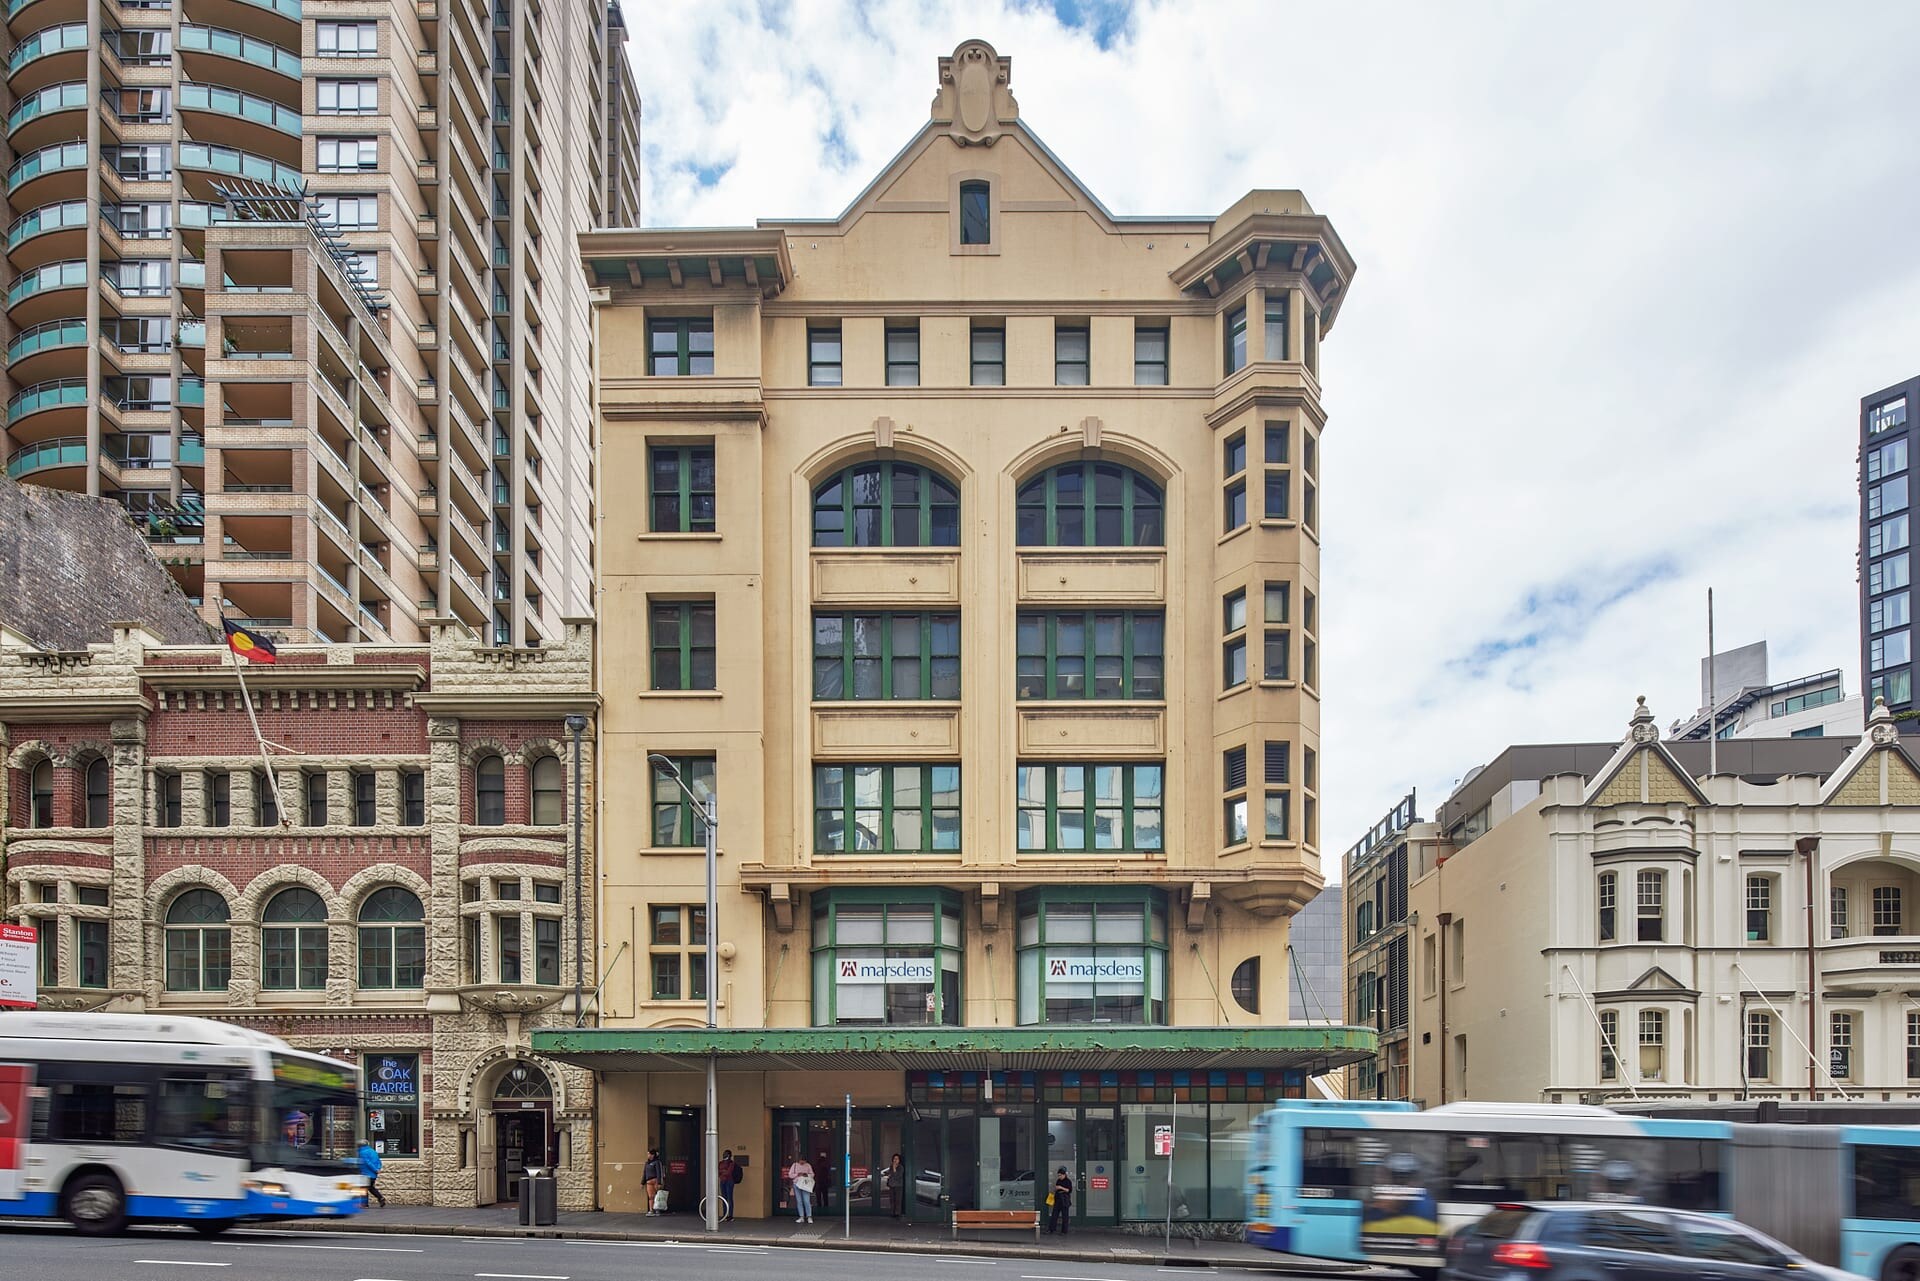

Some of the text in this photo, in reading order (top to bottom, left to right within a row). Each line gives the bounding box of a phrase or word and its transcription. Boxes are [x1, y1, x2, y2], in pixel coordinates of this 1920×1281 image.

[3, 927, 33, 937] Stanton
[861, 961, 932, 977] marsdens
[1071, 960, 1142, 976] marsdens
[379, 1066, 410, 1080] OAK
[371, 1082, 415, 1094] BARREL
[398, 1094, 415, 1102] SHOP
